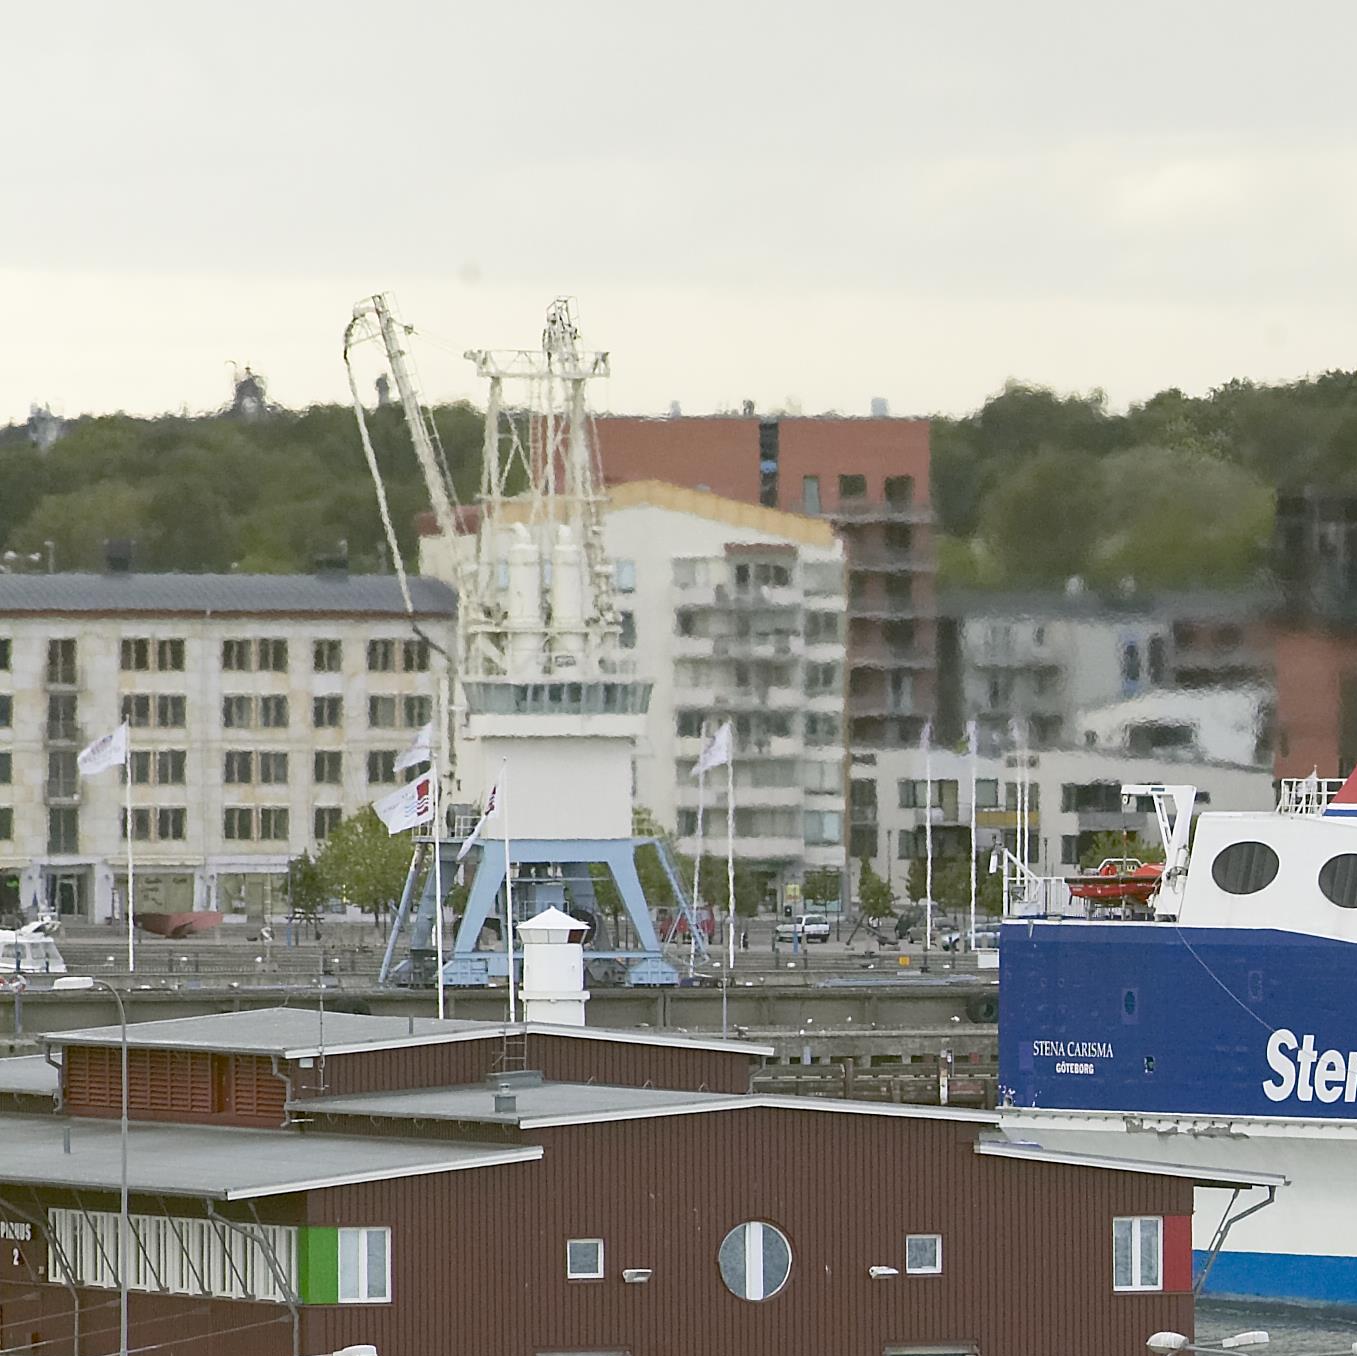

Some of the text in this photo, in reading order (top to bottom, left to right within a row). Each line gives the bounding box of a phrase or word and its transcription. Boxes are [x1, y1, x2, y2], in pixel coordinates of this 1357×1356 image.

[1033, 1040, 1114, 1058] STENA CARISMA
[1055, 1061, 1094, 1075] GÖTEBORG
[13, 1248, 19, 1266] 2
